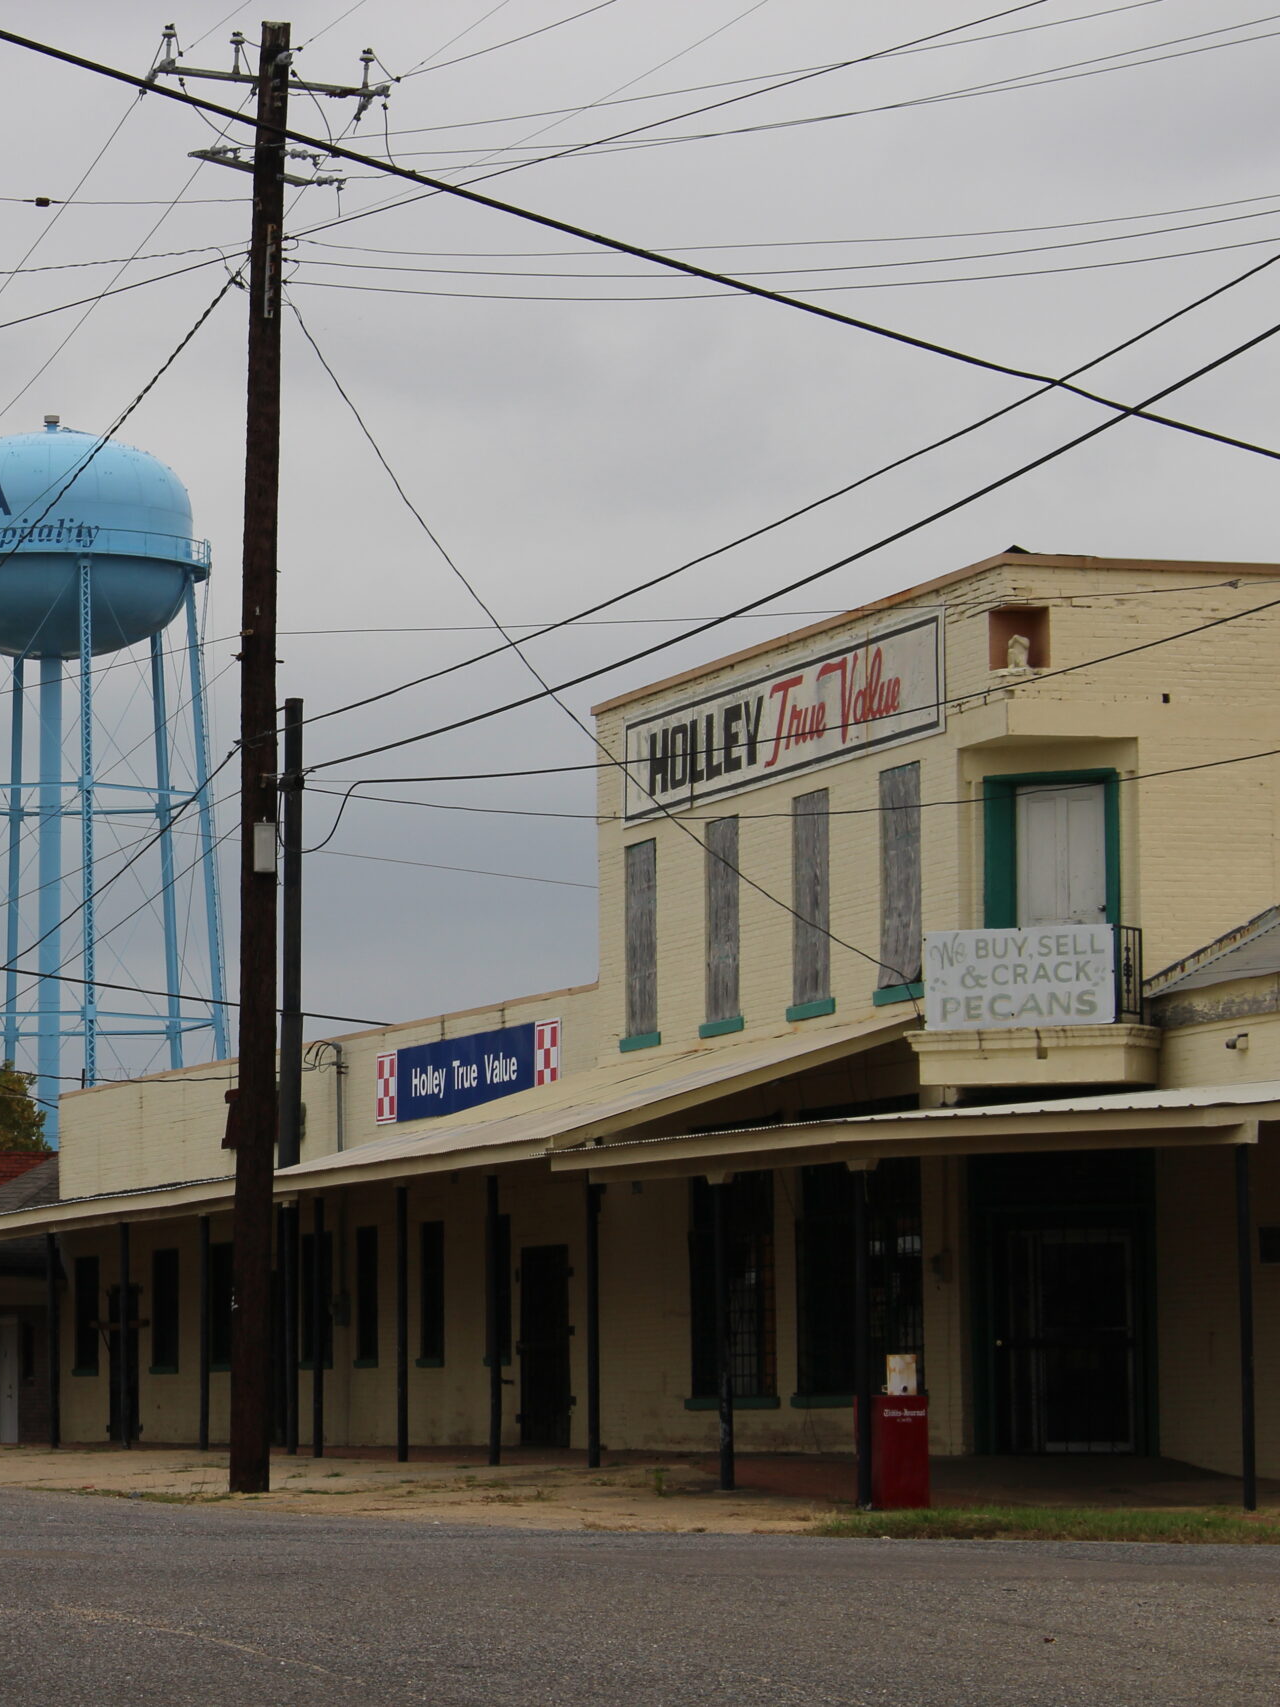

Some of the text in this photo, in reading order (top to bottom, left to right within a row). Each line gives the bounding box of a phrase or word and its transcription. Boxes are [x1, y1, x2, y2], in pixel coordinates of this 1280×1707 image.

[649, 647, 901, 796] HOLLEY True Value
[928, 933, 967, 970] We
[1038, 933, 1106, 957] SELL
[940, 989, 1098, 1023] PECANS
[412, 1052, 517, 1098] Holley True Value
